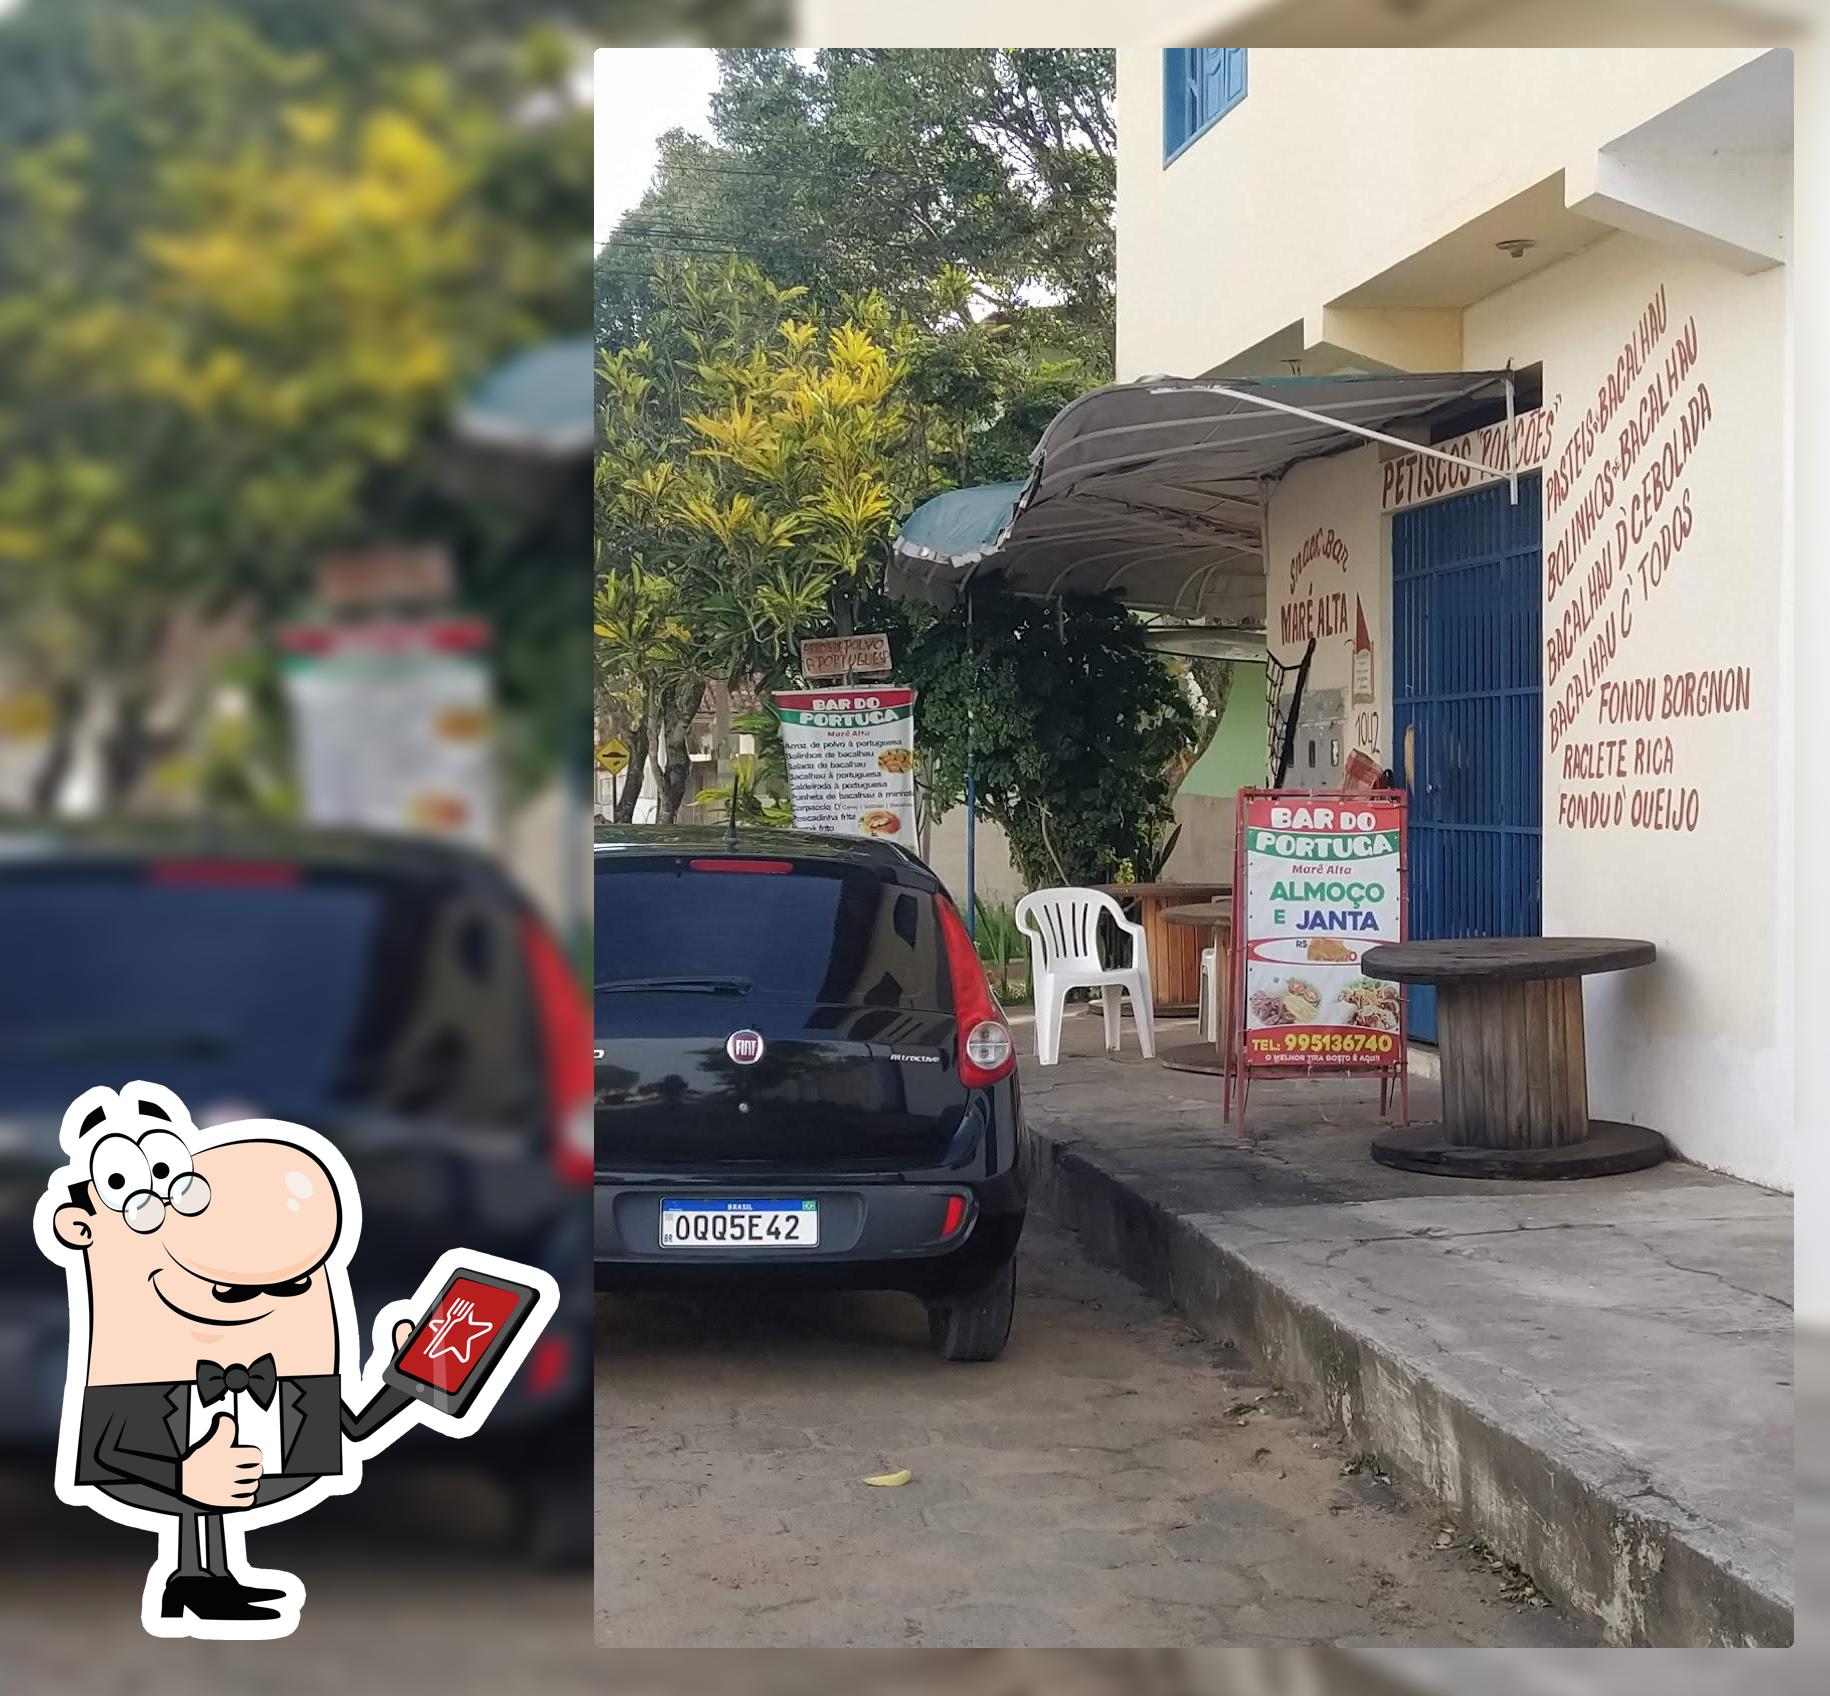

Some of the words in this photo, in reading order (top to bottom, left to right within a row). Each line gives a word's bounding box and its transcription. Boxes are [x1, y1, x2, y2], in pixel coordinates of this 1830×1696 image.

[1546, 408, 1595, 522] PASTEIS
[1598, 283, 1667, 434] BACALHAU
[1547, 460, 1614, 602] BOLINHOS
[1619, 315, 1698, 482] BACALHAU
[1382, 437, 1472, 509] PETISCOS
[1281, 582, 1314, 646] MARÉ
[1317, 593, 1348, 638] ALTA
[1547, 540, 1613, 687] BACALHAU
[1549, 611, 1617, 754] BACALHAU
[1637, 487, 1693, 601] TODOS
[812, 699, 850, 712] BAR
[854, 697, 880, 709] DO
[1599, 677, 1656, 724] FONDU
[1661, 666, 1751, 720] BORGNON
[800, 709, 899, 727] PORTUGA
[810, 741, 820, 749] de
[823, 740, 846, 750] polvo
[856, 738, 902, 748] portuguesa
[825, 750, 835, 759] de
[837, 749, 874, 758] bacalhau
[830, 760, 867, 769] bacalhau
[1563, 739, 1627, 780] RACLETE
[1634, 736, 1674, 775] RICA
[836, 771, 881, 781] portuguesa
[842, 781, 888, 791] portuguesa
[839, 792, 875, 800] bacalhau
[1270, 807, 1334, 830] BAR
[1340, 812, 1376, 831] DO
[1558, 791, 1611, 829] FONDU
[1255, 832, 1393, 858] PORTUGA
[1326, 865, 1352, 875] Alta
[1269, 881, 1385, 909] ALMOÇO
[1274, 909, 1285, 924] E
[1295, 910, 1380, 931] JANTA
[1296, 940, 1308, 948] R$
[736, 1039, 757, 1056] FIAT
[1252, 1039, 1280, 1051] TEL:
[1284, 1033, 1393, 1052] 995136740
